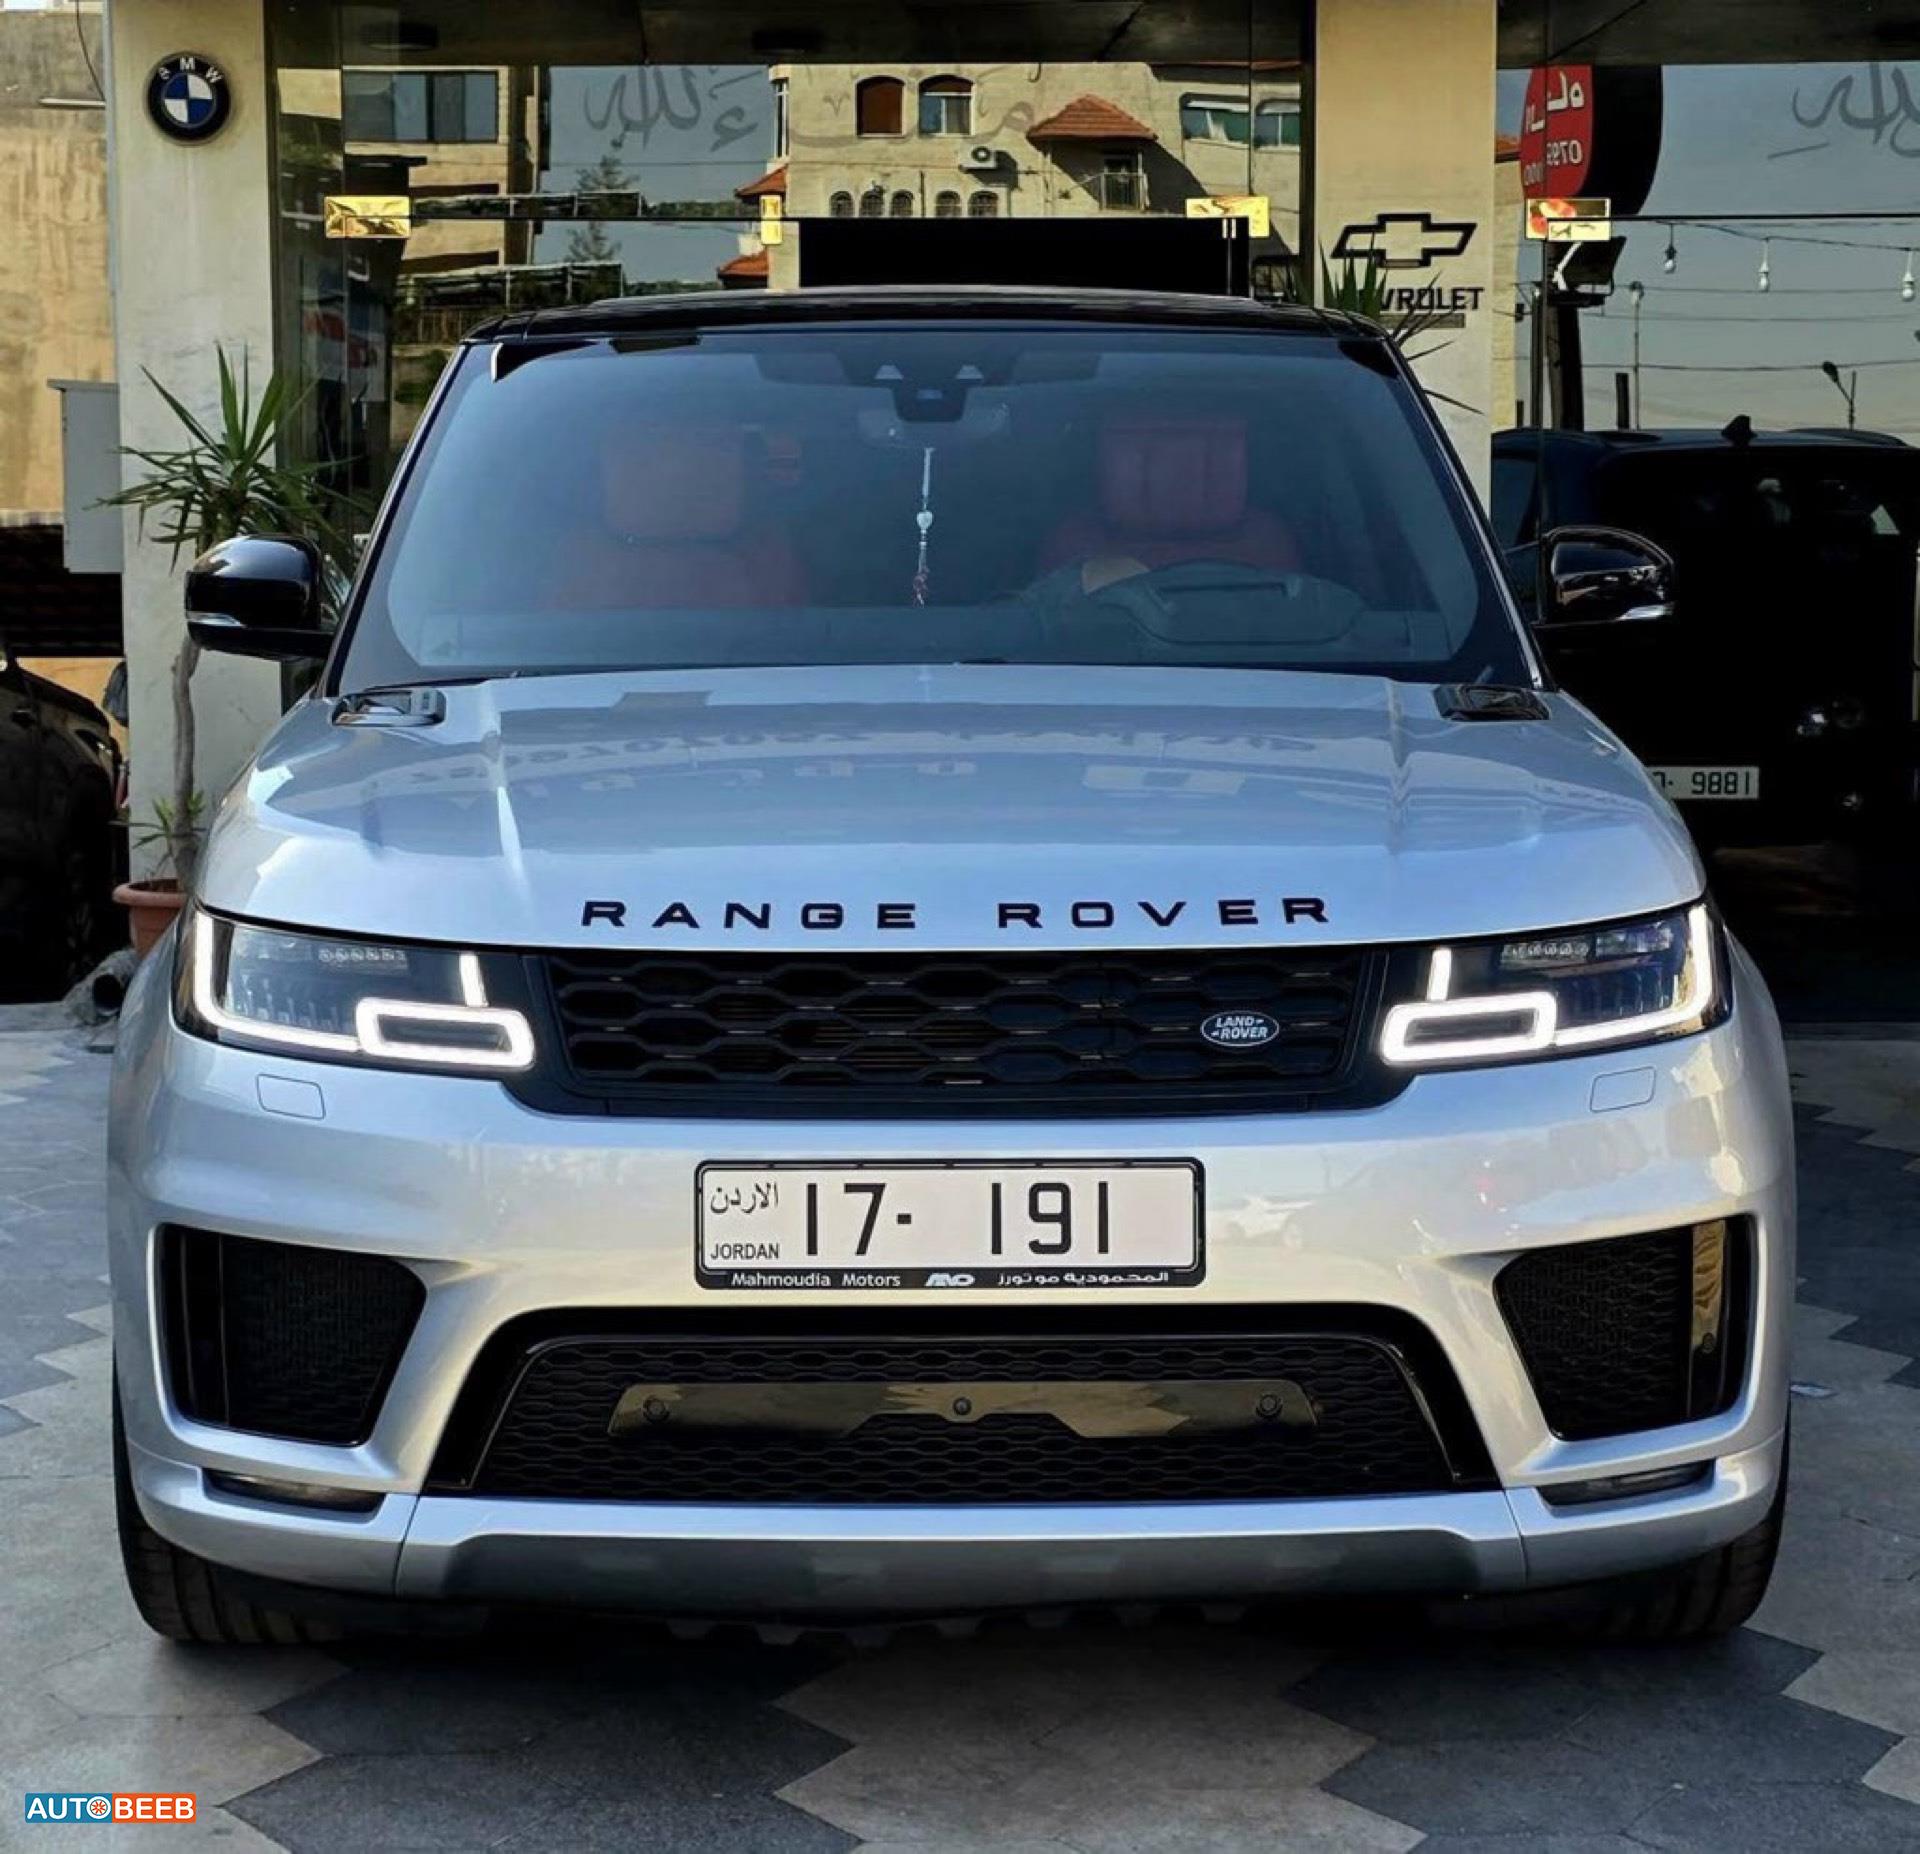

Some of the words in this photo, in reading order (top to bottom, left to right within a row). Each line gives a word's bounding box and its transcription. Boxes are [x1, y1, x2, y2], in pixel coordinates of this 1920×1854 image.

[158, 56, 222, 83] BMW
[1691, 771, 1750, 796] 9881
[581, 900, 916, 930] RANGE
[998, 897, 1329, 929] ROVER
[710, 1182, 779, 1214] الاردن
[991, 1181, 1109, 1255] 191
[710, 1243, 780, 1260] JORDAN
[731, 1272, 832, 1288] Mahmoudia
[842, 1273, 901, 1288] Motors
[1063, 1271, 1169, 1286] المحمودية
